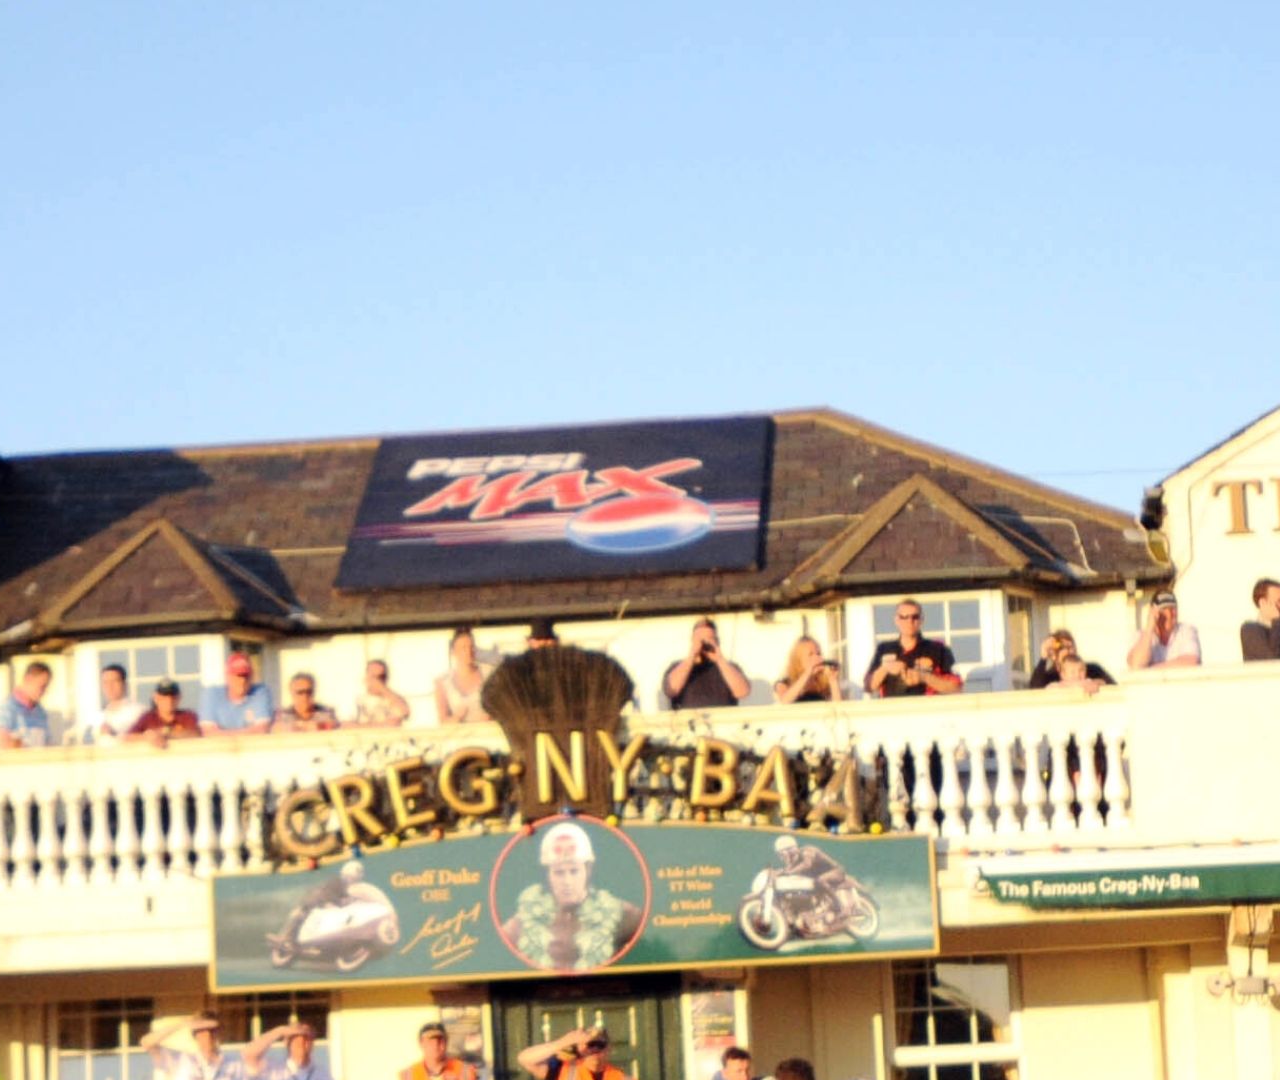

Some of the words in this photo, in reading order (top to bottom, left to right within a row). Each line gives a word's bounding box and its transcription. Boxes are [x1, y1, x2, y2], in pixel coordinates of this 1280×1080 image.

[407, 452, 586, 480] PEPSI
[403, 457, 703, 520] MAX
[273, 746, 500, 856] CREG
[535, 730, 648, 804] NY
[690, 736, 865, 833] BAA
[389, 869, 436, 888] Geoff
[438, 867, 481, 885] Duke
[998, 880, 1029, 897] The
[1031, 878, 1096, 897] Famous
